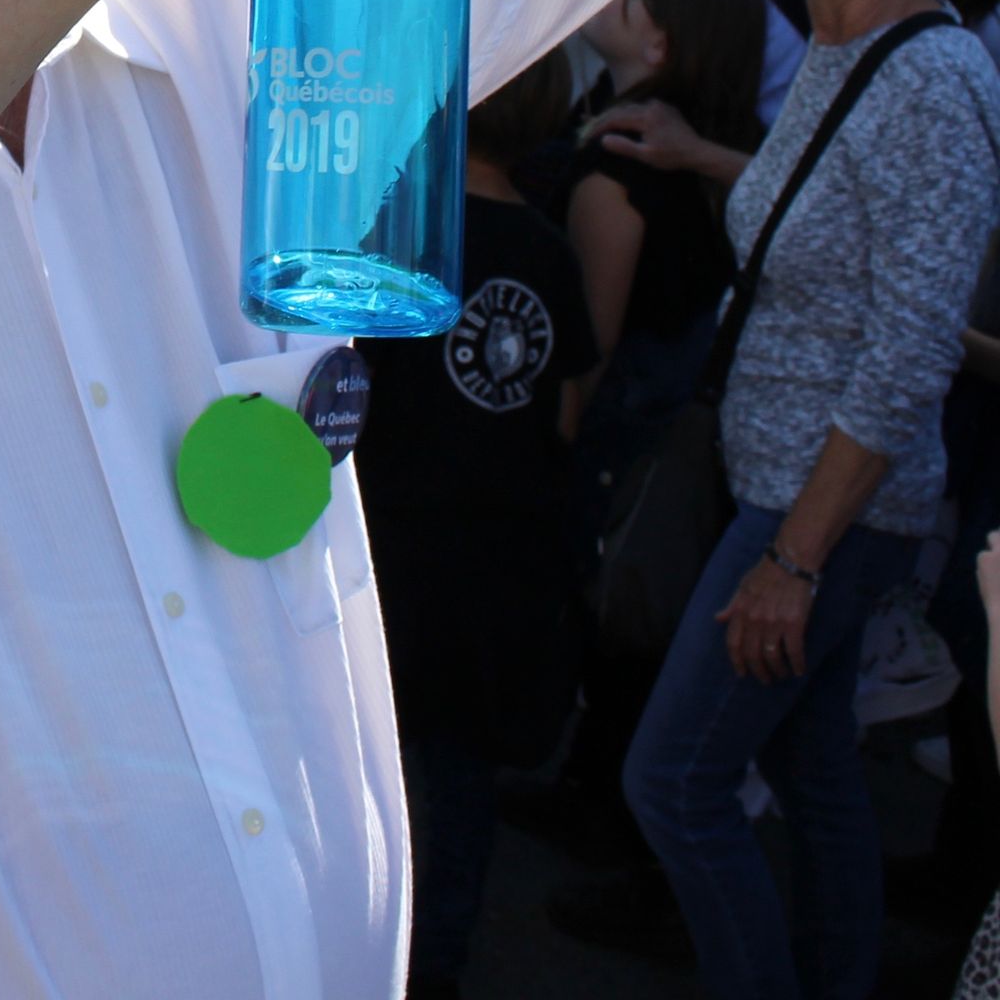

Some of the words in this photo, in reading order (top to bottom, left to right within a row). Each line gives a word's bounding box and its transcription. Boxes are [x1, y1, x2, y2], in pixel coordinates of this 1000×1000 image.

[270, 47, 361, 79] BLOC
[268, 79, 396, 105] Québécois
[266, 107, 360, 175] 2019
[336, 377, 348, 393] et
[315, 413, 326, 427] Le
[327, 411, 361, 427] Québec
